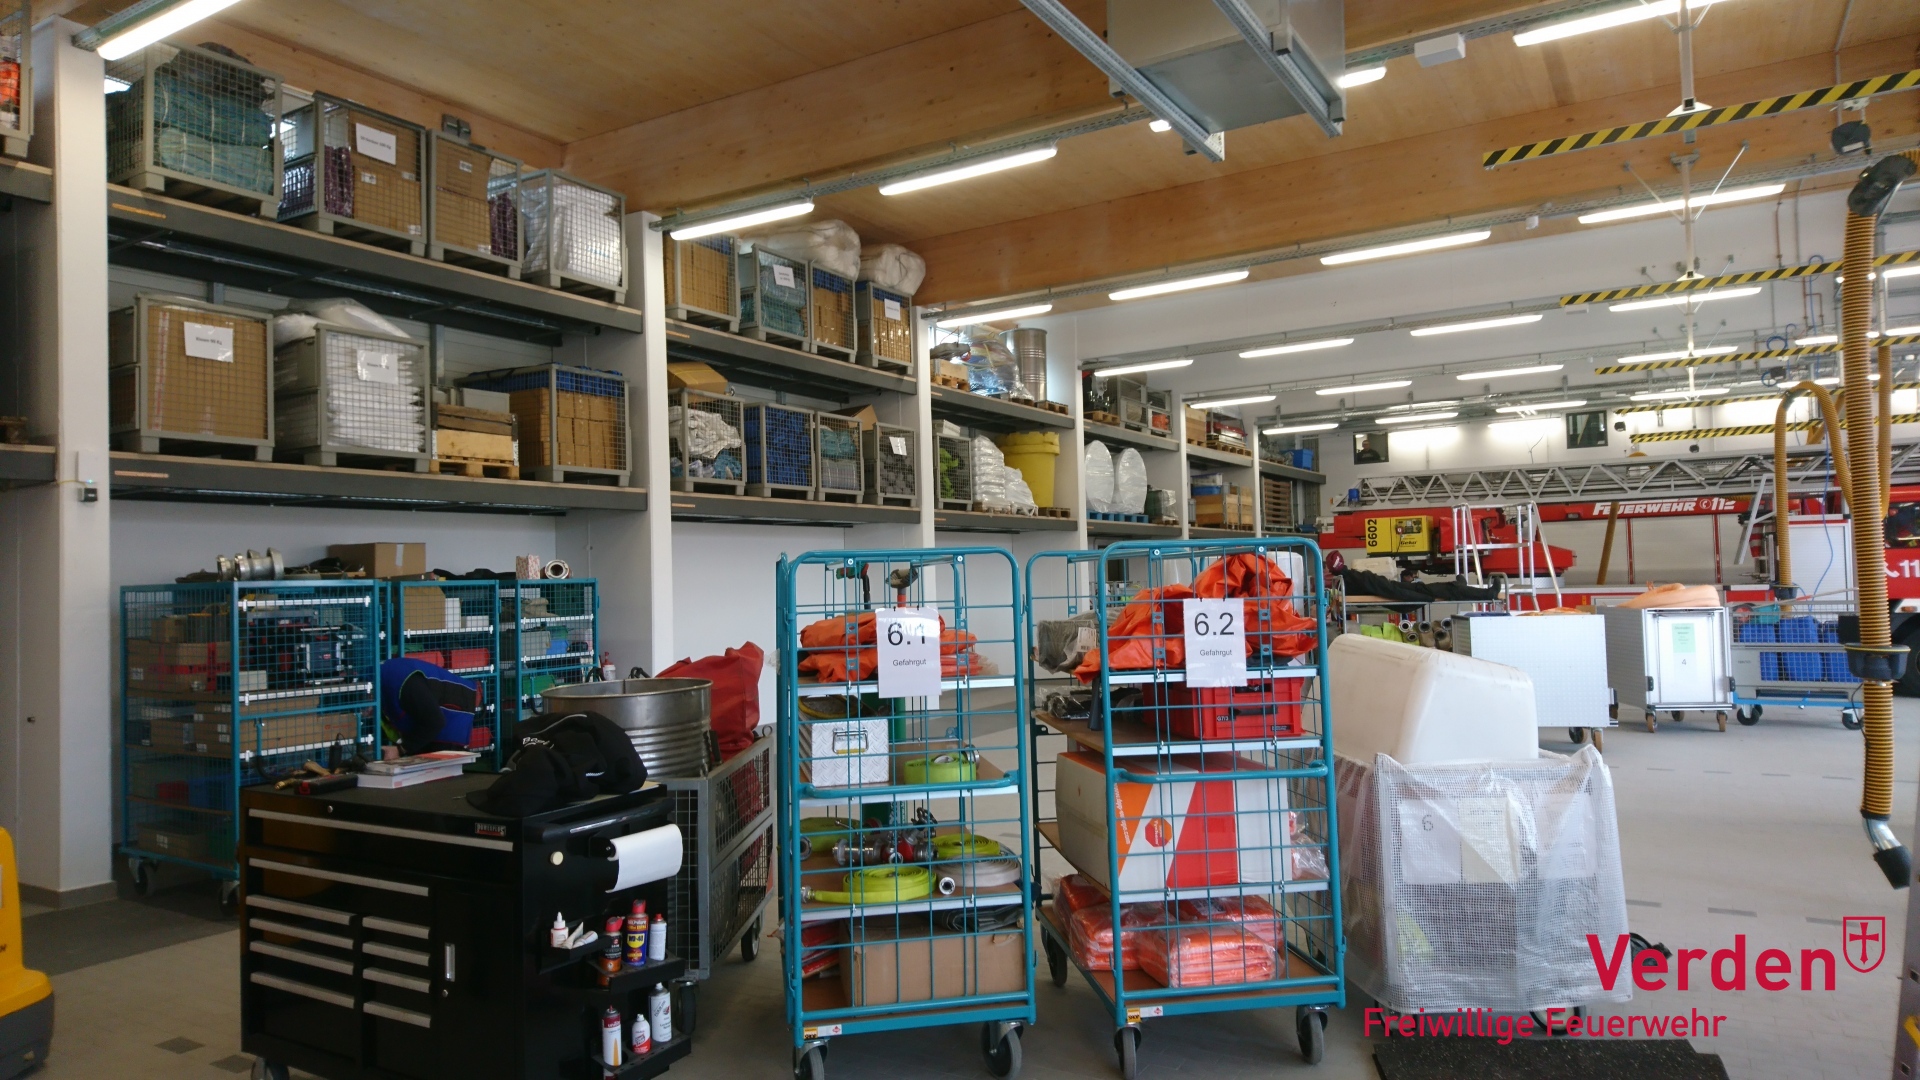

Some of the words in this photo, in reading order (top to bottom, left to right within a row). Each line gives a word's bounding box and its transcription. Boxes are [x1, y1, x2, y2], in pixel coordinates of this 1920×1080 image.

[1367, 519, 1378, 547] 6602
[887, 622, 926, 646] 6.1
[1194, 612, 1235, 636] 6.2
[892, 658, 927, 667] Gefahrgut
[1200, 649, 1233, 657] Gefahrgut
[1421, 814, 1434, 832] 6
